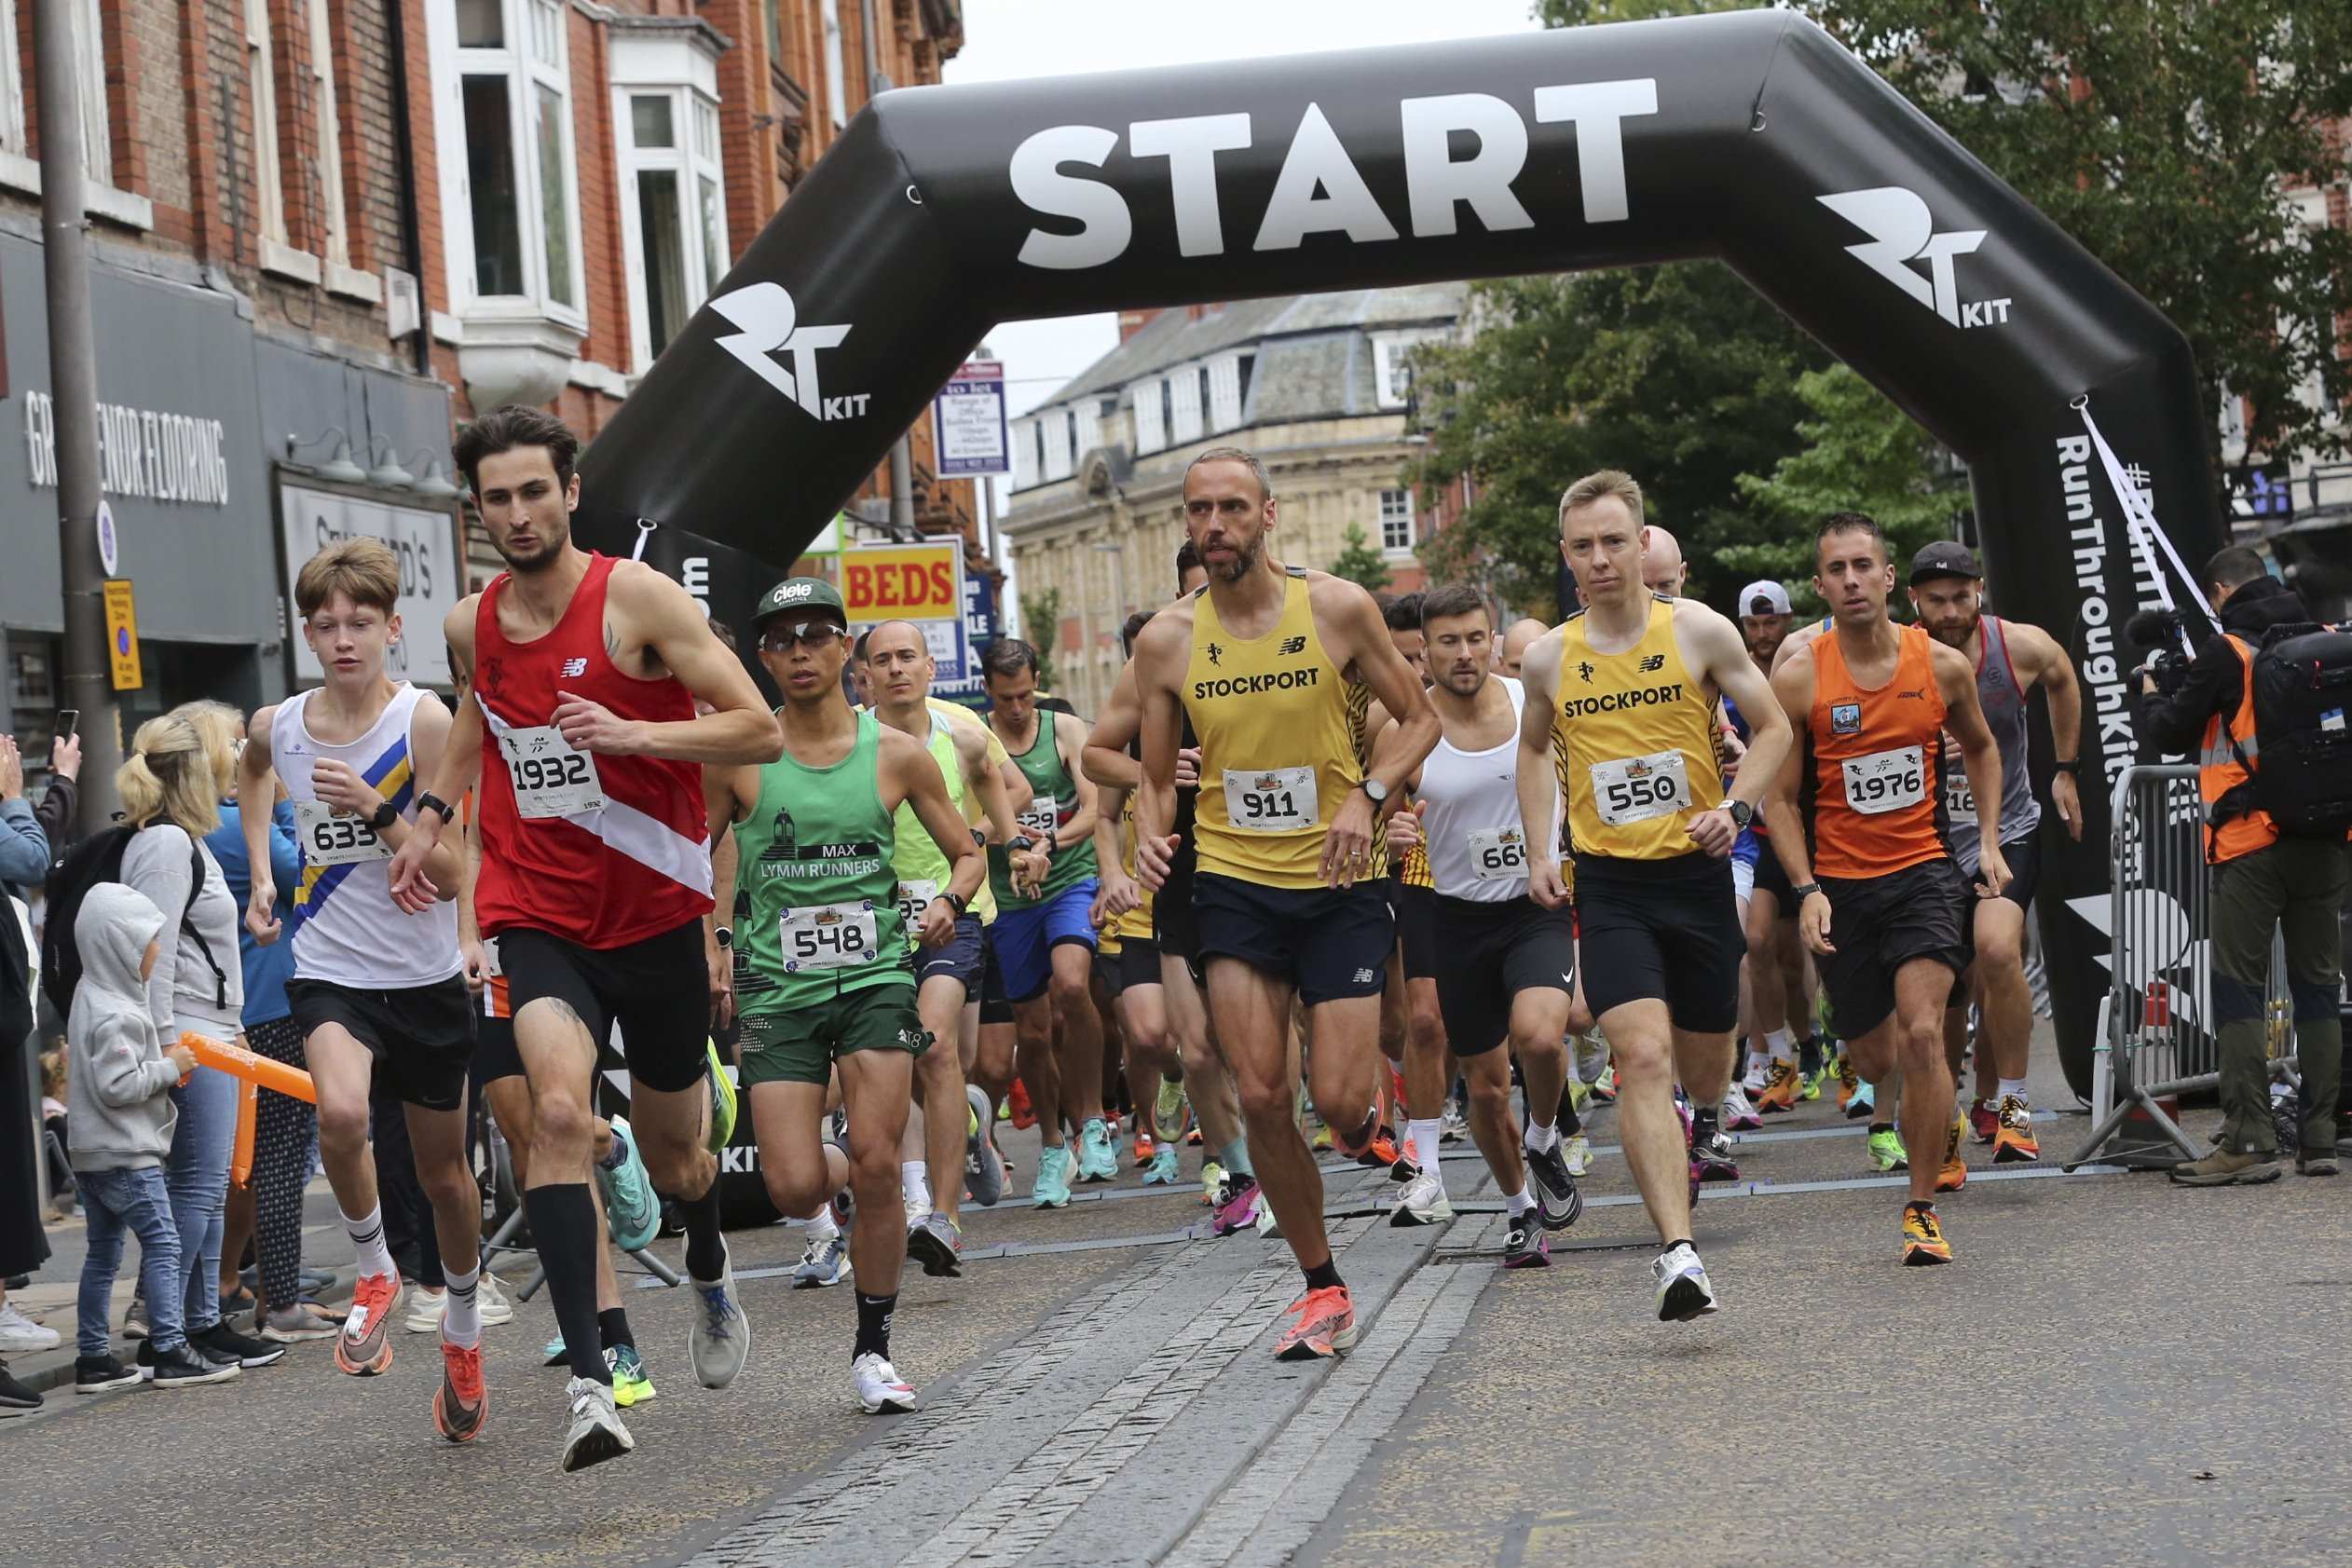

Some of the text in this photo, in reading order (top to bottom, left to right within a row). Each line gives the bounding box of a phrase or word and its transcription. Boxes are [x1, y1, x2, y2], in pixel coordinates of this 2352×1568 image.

[1009, 77, 1658, 270] START
[1962, 298, 2012, 328] KIT
[824, 393, 870, 421] KIT
[26, 390, 227, 505] GRNOR FLOORING
[846, 561, 953, 608] BEDS
[1195, 668, 1319, 701] STOCKPORT
[1565, 684, 1683, 717] STOCKPORT
[513, 754, 591, 790] 1932
[1851, 770, 1921, 802] 1976
[583, 800, 601, 810] 1932
[1242, 791, 1299, 818] 911
[1607, 775, 1676, 811] 550
[314, 819, 377, 851] 633
[823, 844, 857, 858] MAX
[760, 859, 880, 878] LYMM RUNNERS
[795, 925, 864, 958] 548
[721, 1146, 762, 1173] KI
